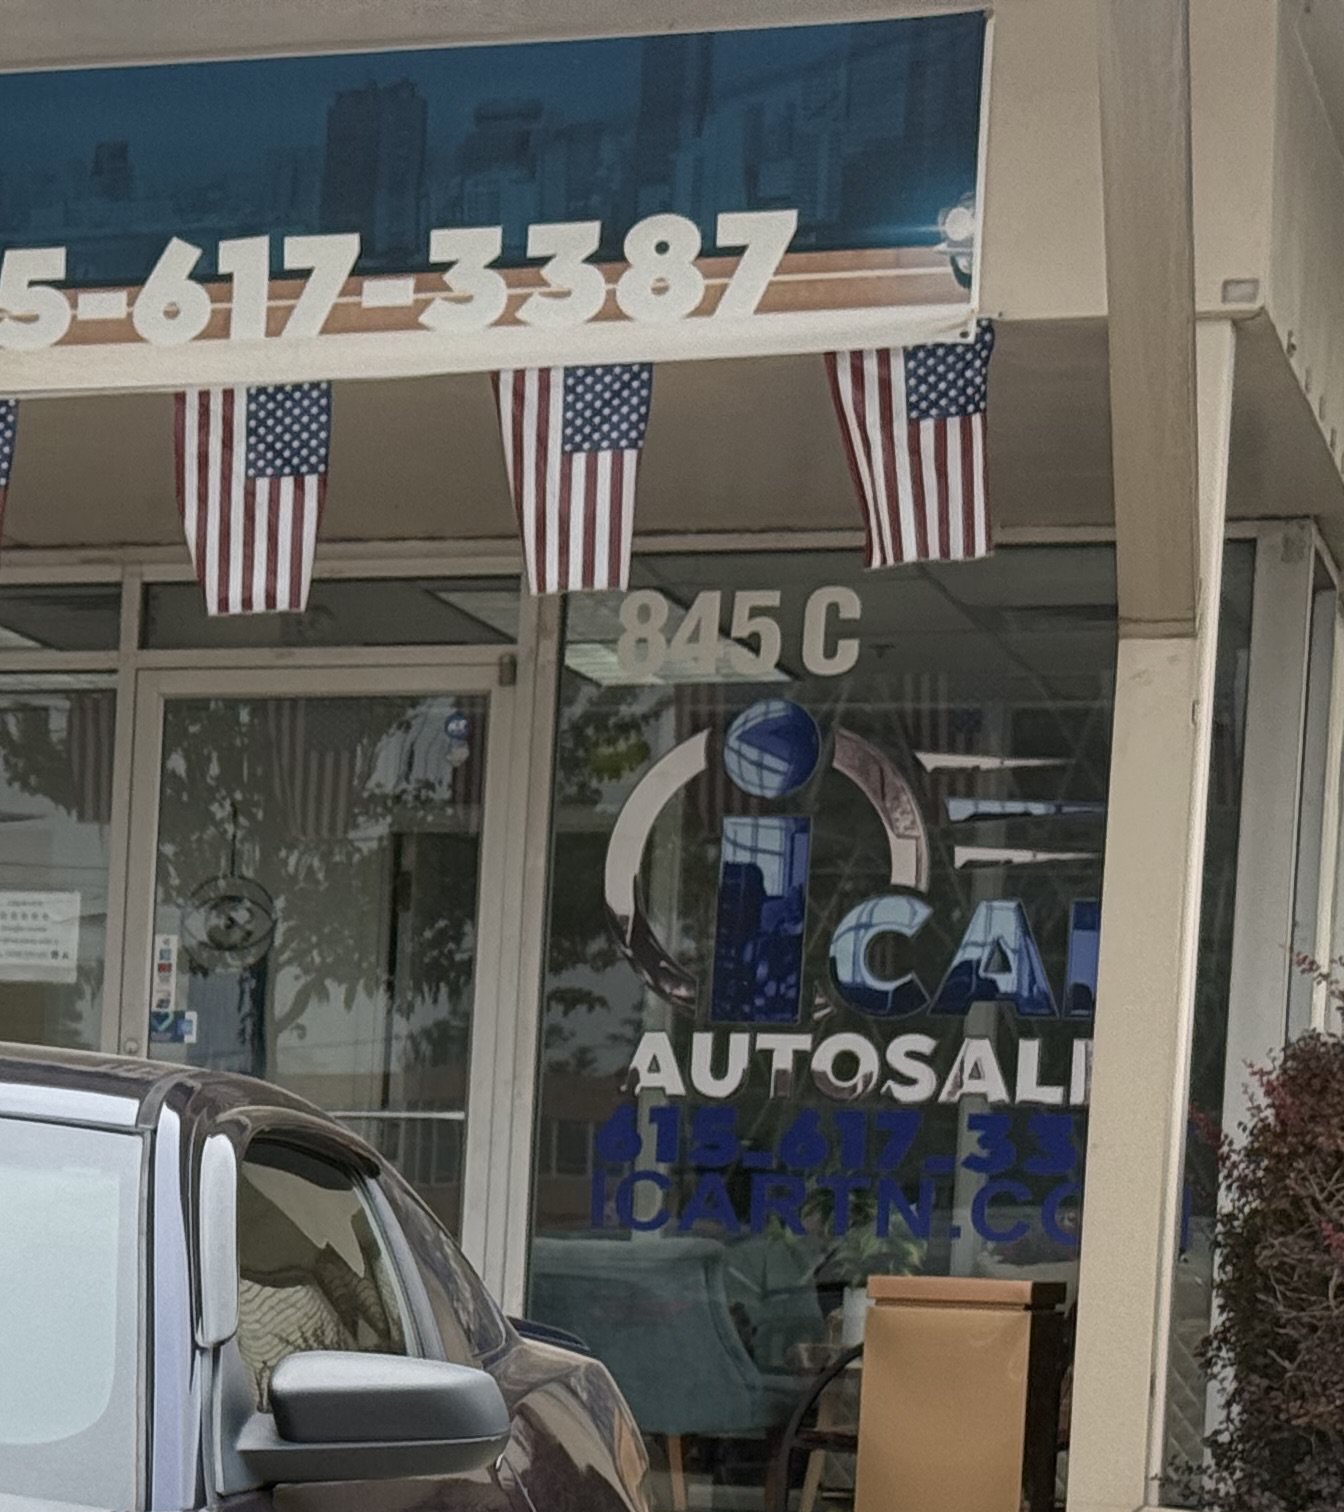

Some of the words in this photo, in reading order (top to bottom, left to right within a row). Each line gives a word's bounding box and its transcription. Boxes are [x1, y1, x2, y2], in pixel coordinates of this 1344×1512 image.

[616, 588, 782, 676] 845
[802, 584, 862, 677] C
[590, 1168, 1080, 1247] ICARTN.CO
